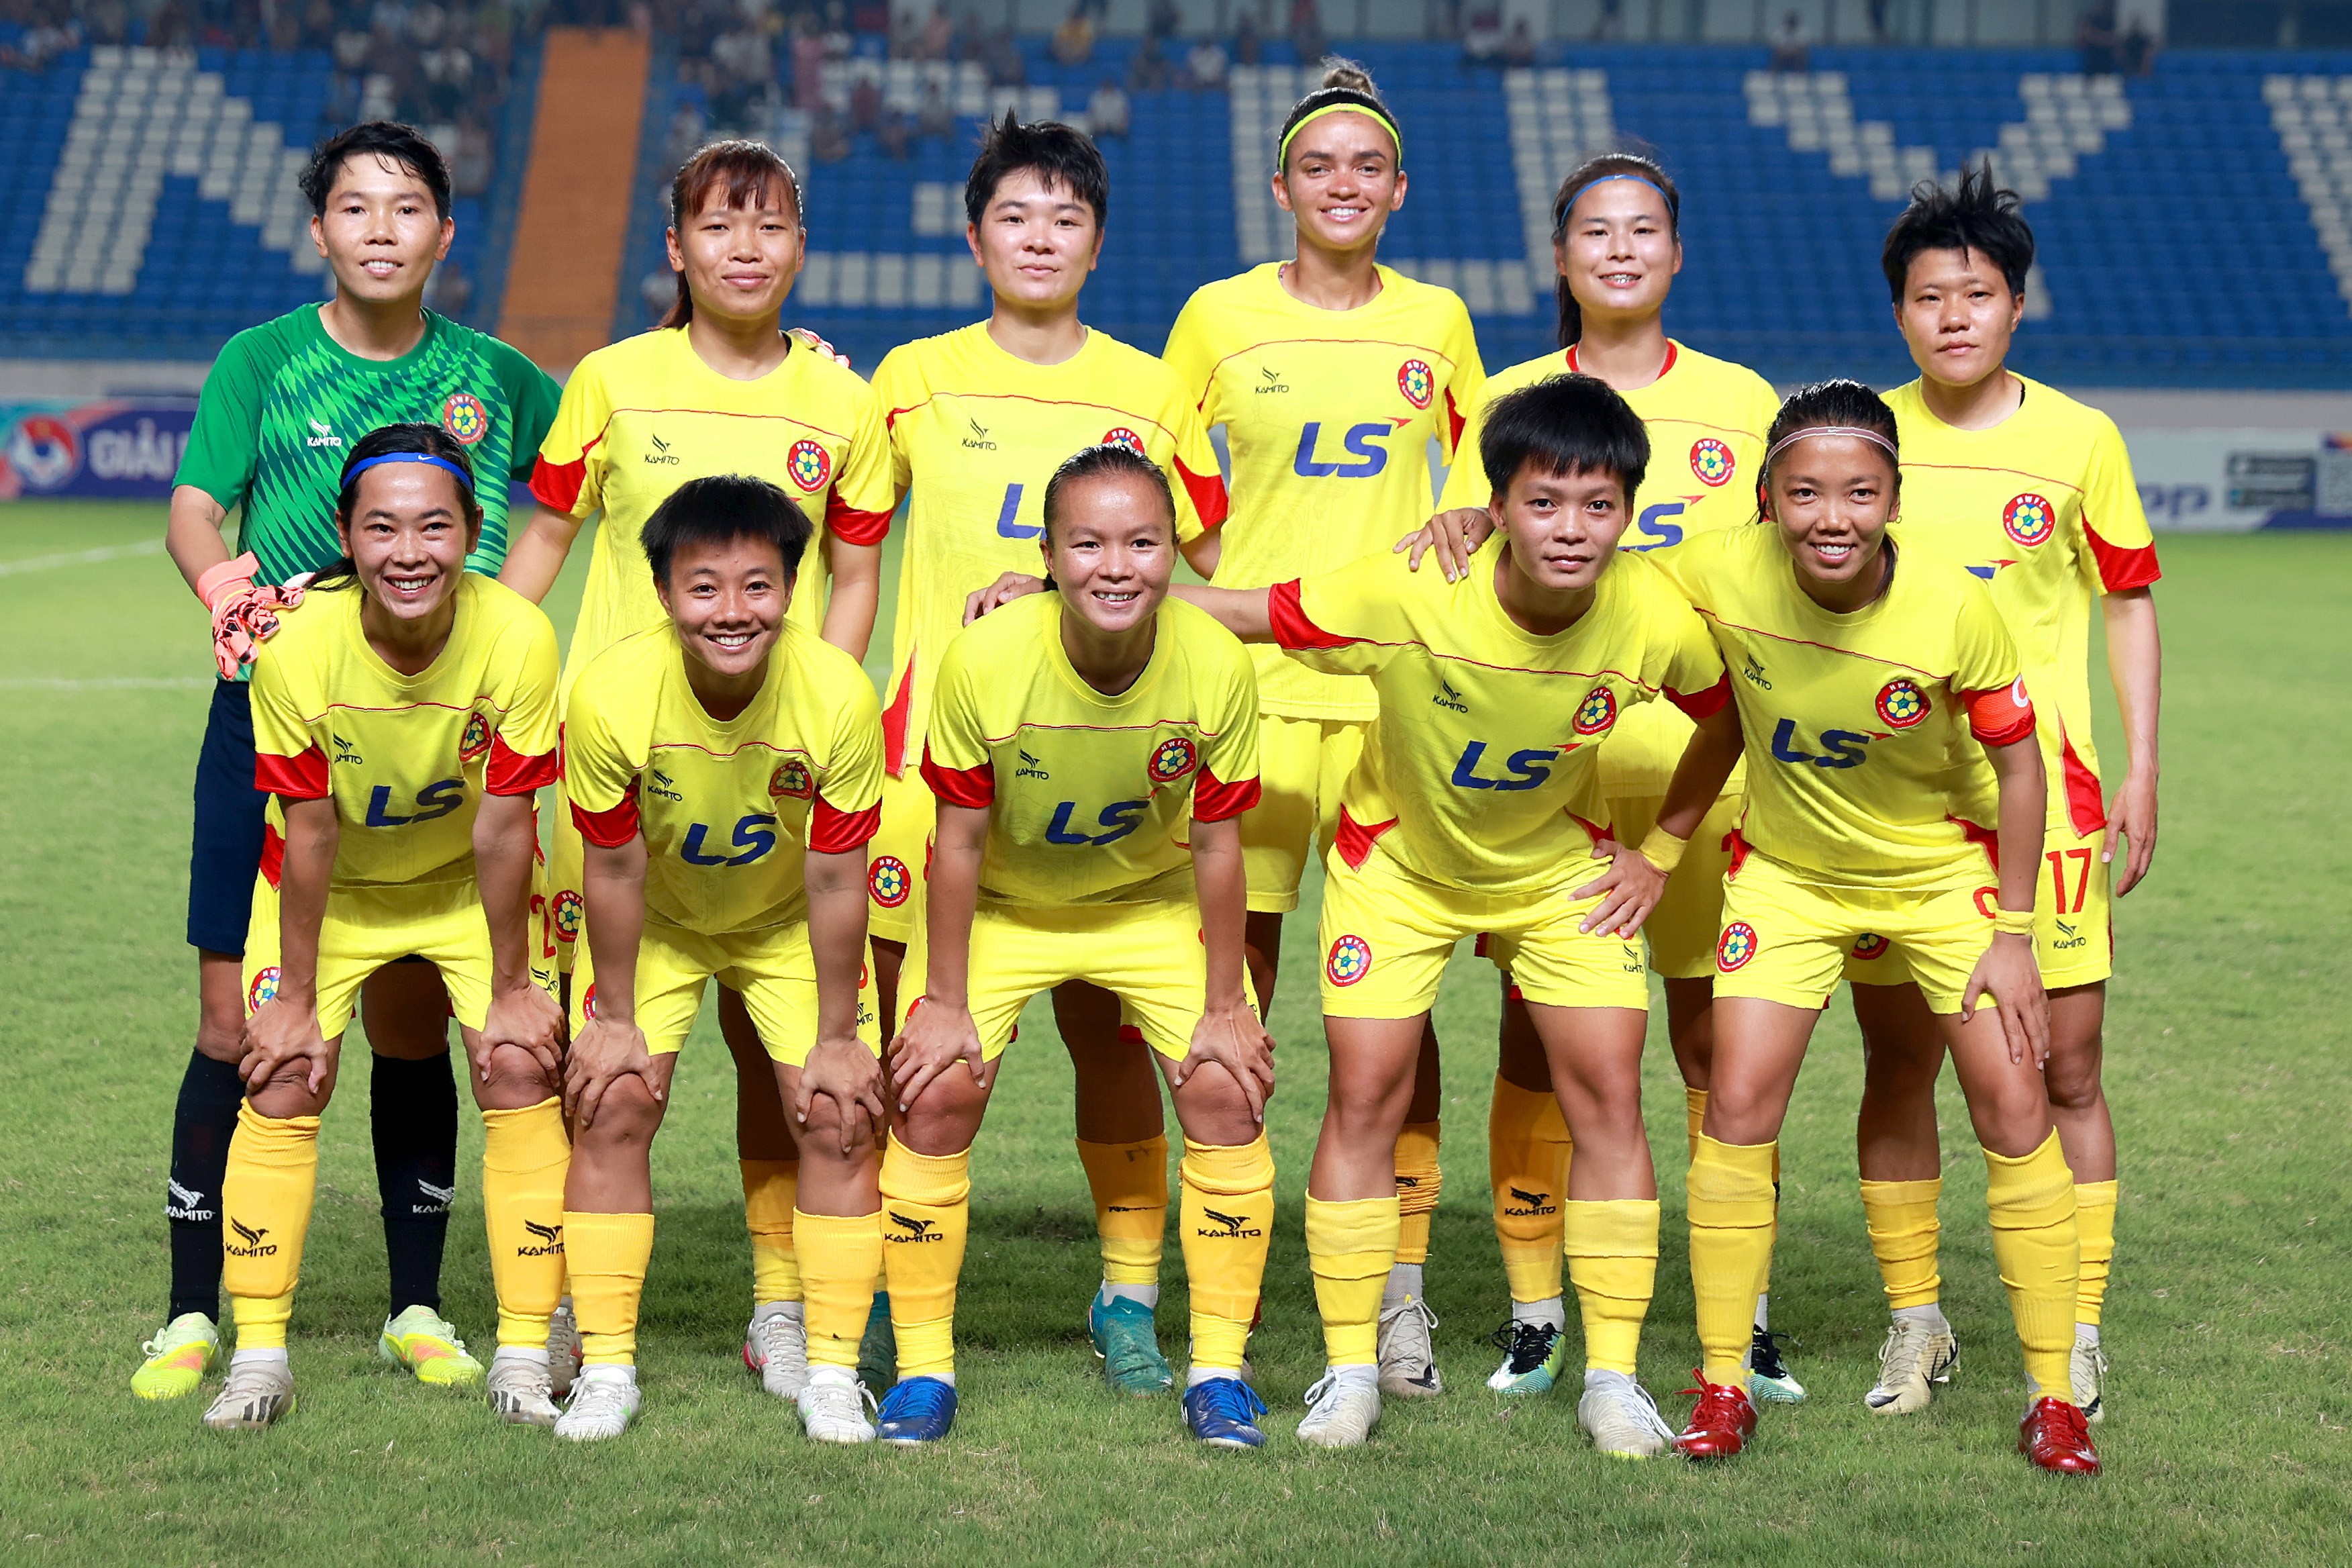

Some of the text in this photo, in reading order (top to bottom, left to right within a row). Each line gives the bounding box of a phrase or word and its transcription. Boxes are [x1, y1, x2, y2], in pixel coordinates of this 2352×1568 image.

[1255, 384, 1289, 395] KAMITO
[307, 436, 342, 447] KAMITO
[962, 438, 997, 450] KAMITO
[1295, 422, 1392, 478] LS
[644, 453, 680, 465] KAMITO
[1743, 667, 1773, 691] KAMITO
[1432, 695, 1469, 714] KAMITO
[1771, 718, 1870, 769] LS
[334, 753, 363, 765] AMITO
[1451, 740, 1559, 791] LS
[1016, 767, 1050, 780] KAMITO
[648, 785, 683, 801] KAMITO
[366, 779, 465, 827] LS
[1045, 800, 1150, 846] LS
[681, 814, 777, 867] LS
[2045, 847, 2092, 915] 17
[2053, 936, 2087, 949] KAMITO
[856, 1012, 873, 1026] MITO
[165, 1205, 214, 1221] KAMITO
[1505, 1206, 1556, 1216] KAMITO
[884, 1232, 943, 1244] KAMITO
[1198, 1227, 1262, 1238] KAMITO
[226, 1242, 278, 1257] KAMITO
